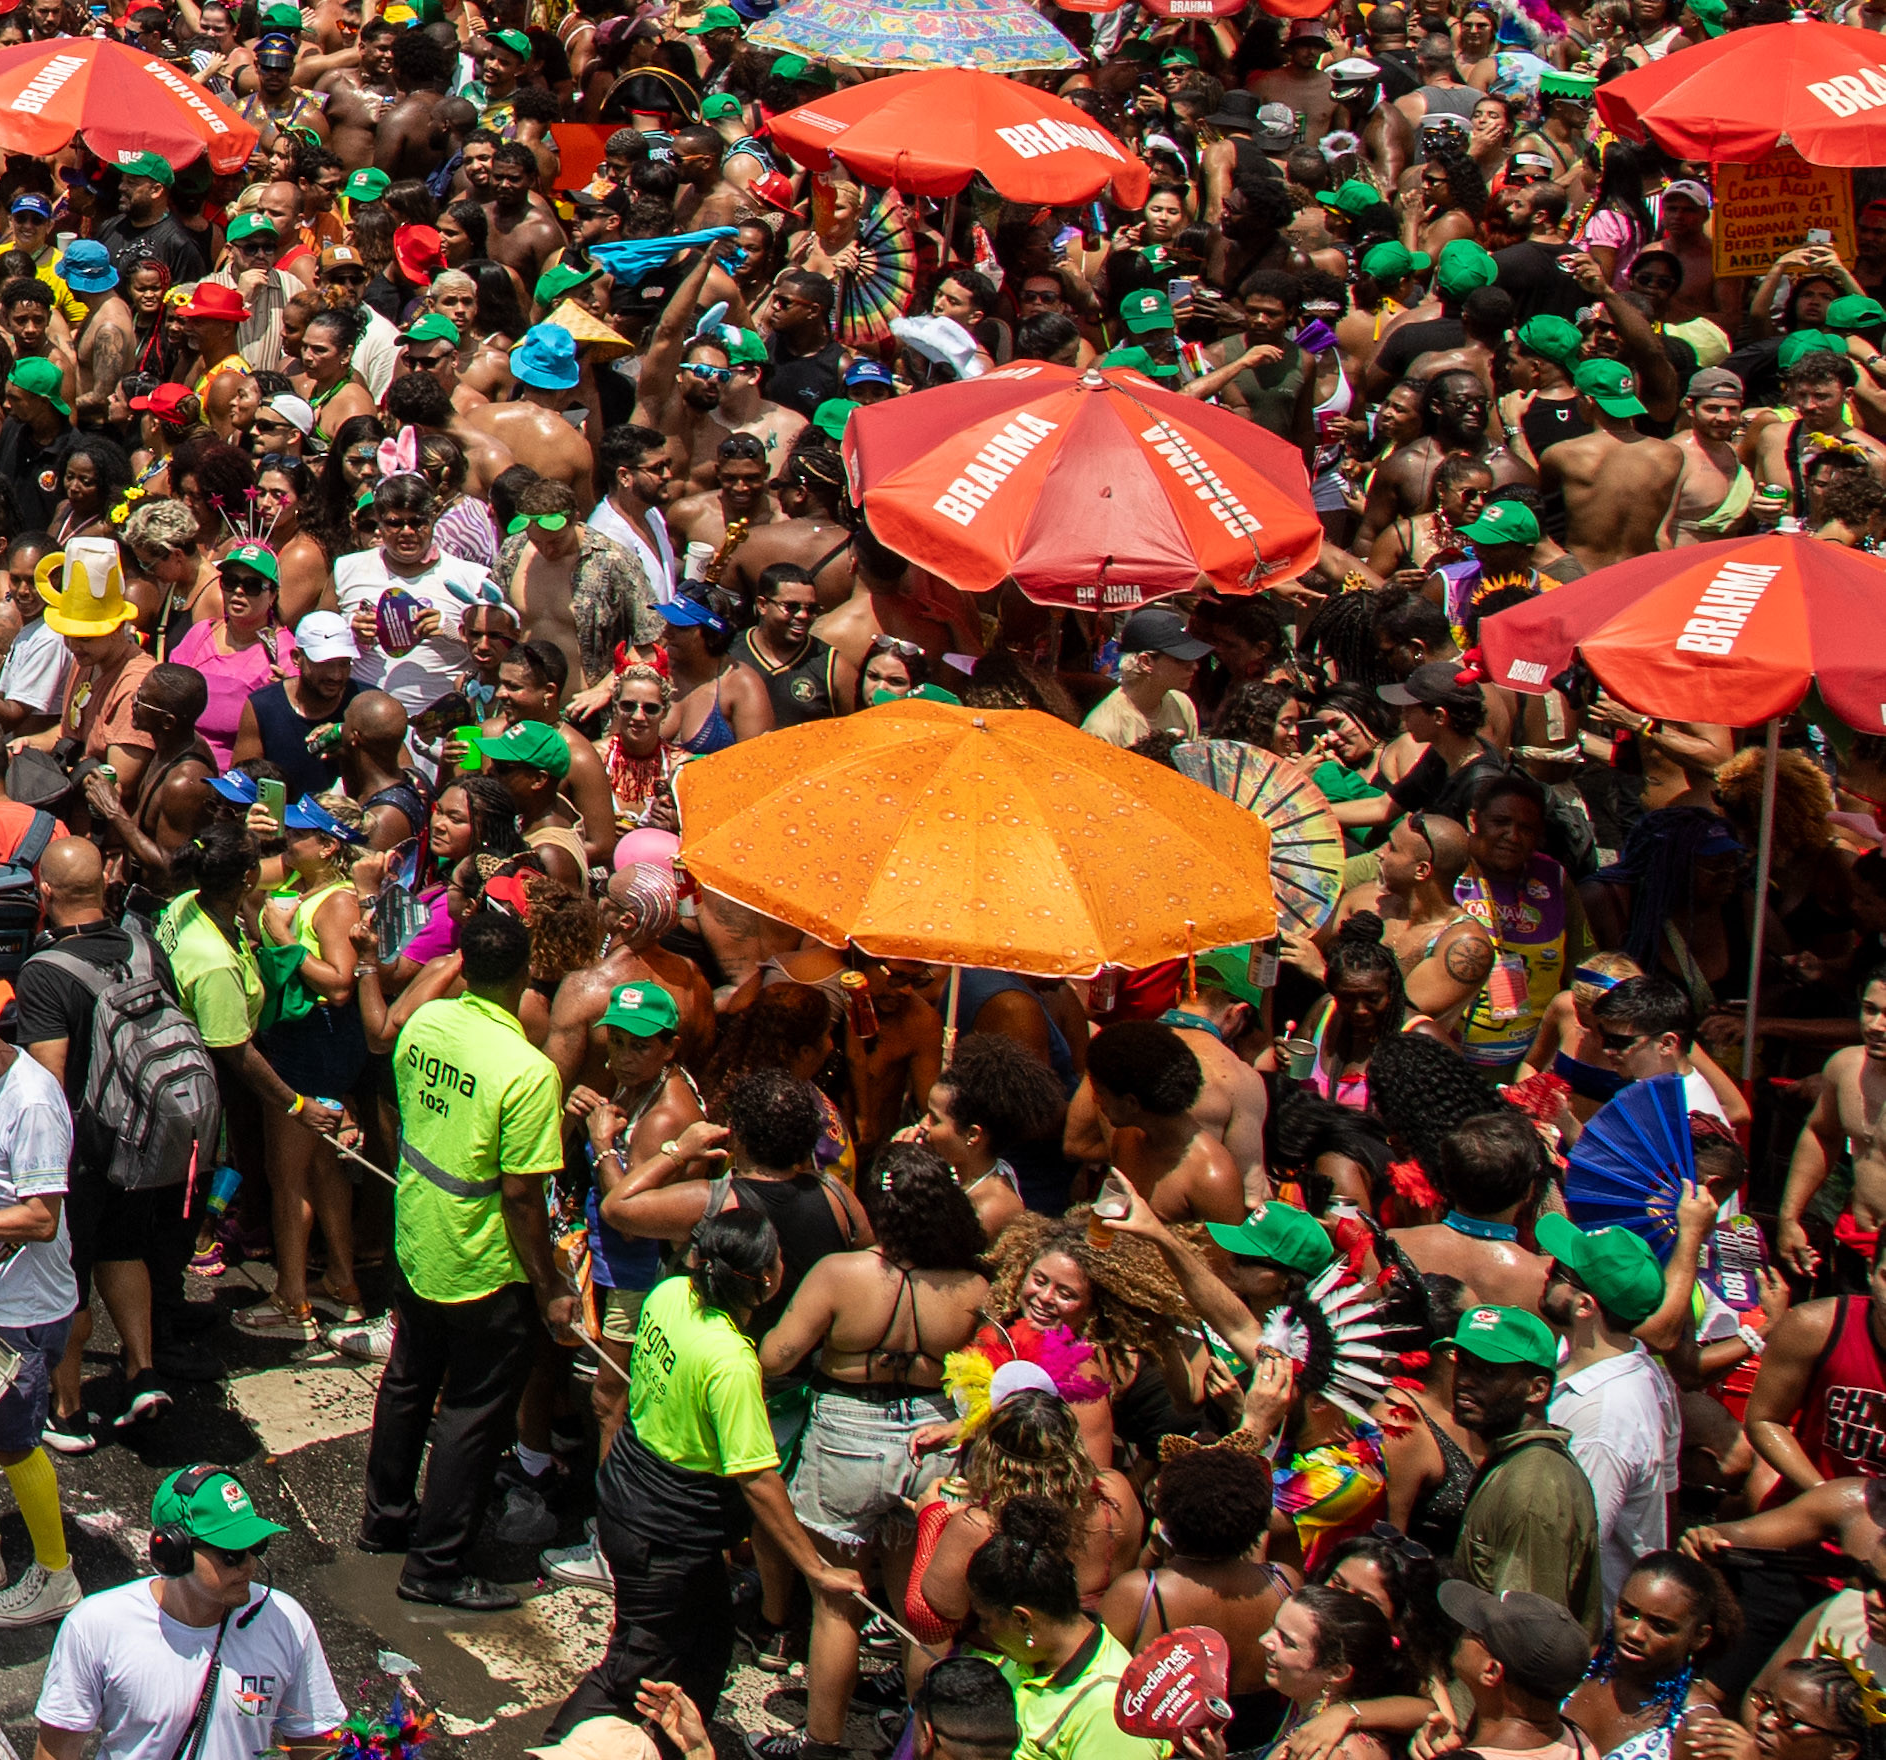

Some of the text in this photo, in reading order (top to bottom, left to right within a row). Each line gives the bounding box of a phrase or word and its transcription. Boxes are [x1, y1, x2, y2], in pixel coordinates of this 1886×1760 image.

[1170, 0, 1213, 14] BRAHMA
[11, 56, 88, 115] BRAHMA
[143, 62, 227, 134] BRAHMA
[994, 120, 1127, 164] BRAHMA
[1728, 181, 1769, 201] COCA
[1723, 201, 1799, 218] GUARAVITA
[1803, 216, 1841, 230] SKOL
[1724, 238, 1767, 252] BEATS
[932, 412, 1059, 527] BRAHMA
[1139, 421, 1266, 542] BRAHMA
[1076, 585, 1142, 607] BRAHMA
[1677, 561, 1782, 656] BRAHMA
[1509, 660, 1549, 685] BRAHMA
[407, 1044, 477, 1098] sigma
[419, 1089, 450, 1119] 1021
[1722, 1271, 1747, 1301] 180
[641, 1311, 677, 1376] sigma
[1131, 1644, 1190, 1712] predialnet
[1172, 1690, 1192, 1713] FOLIA
